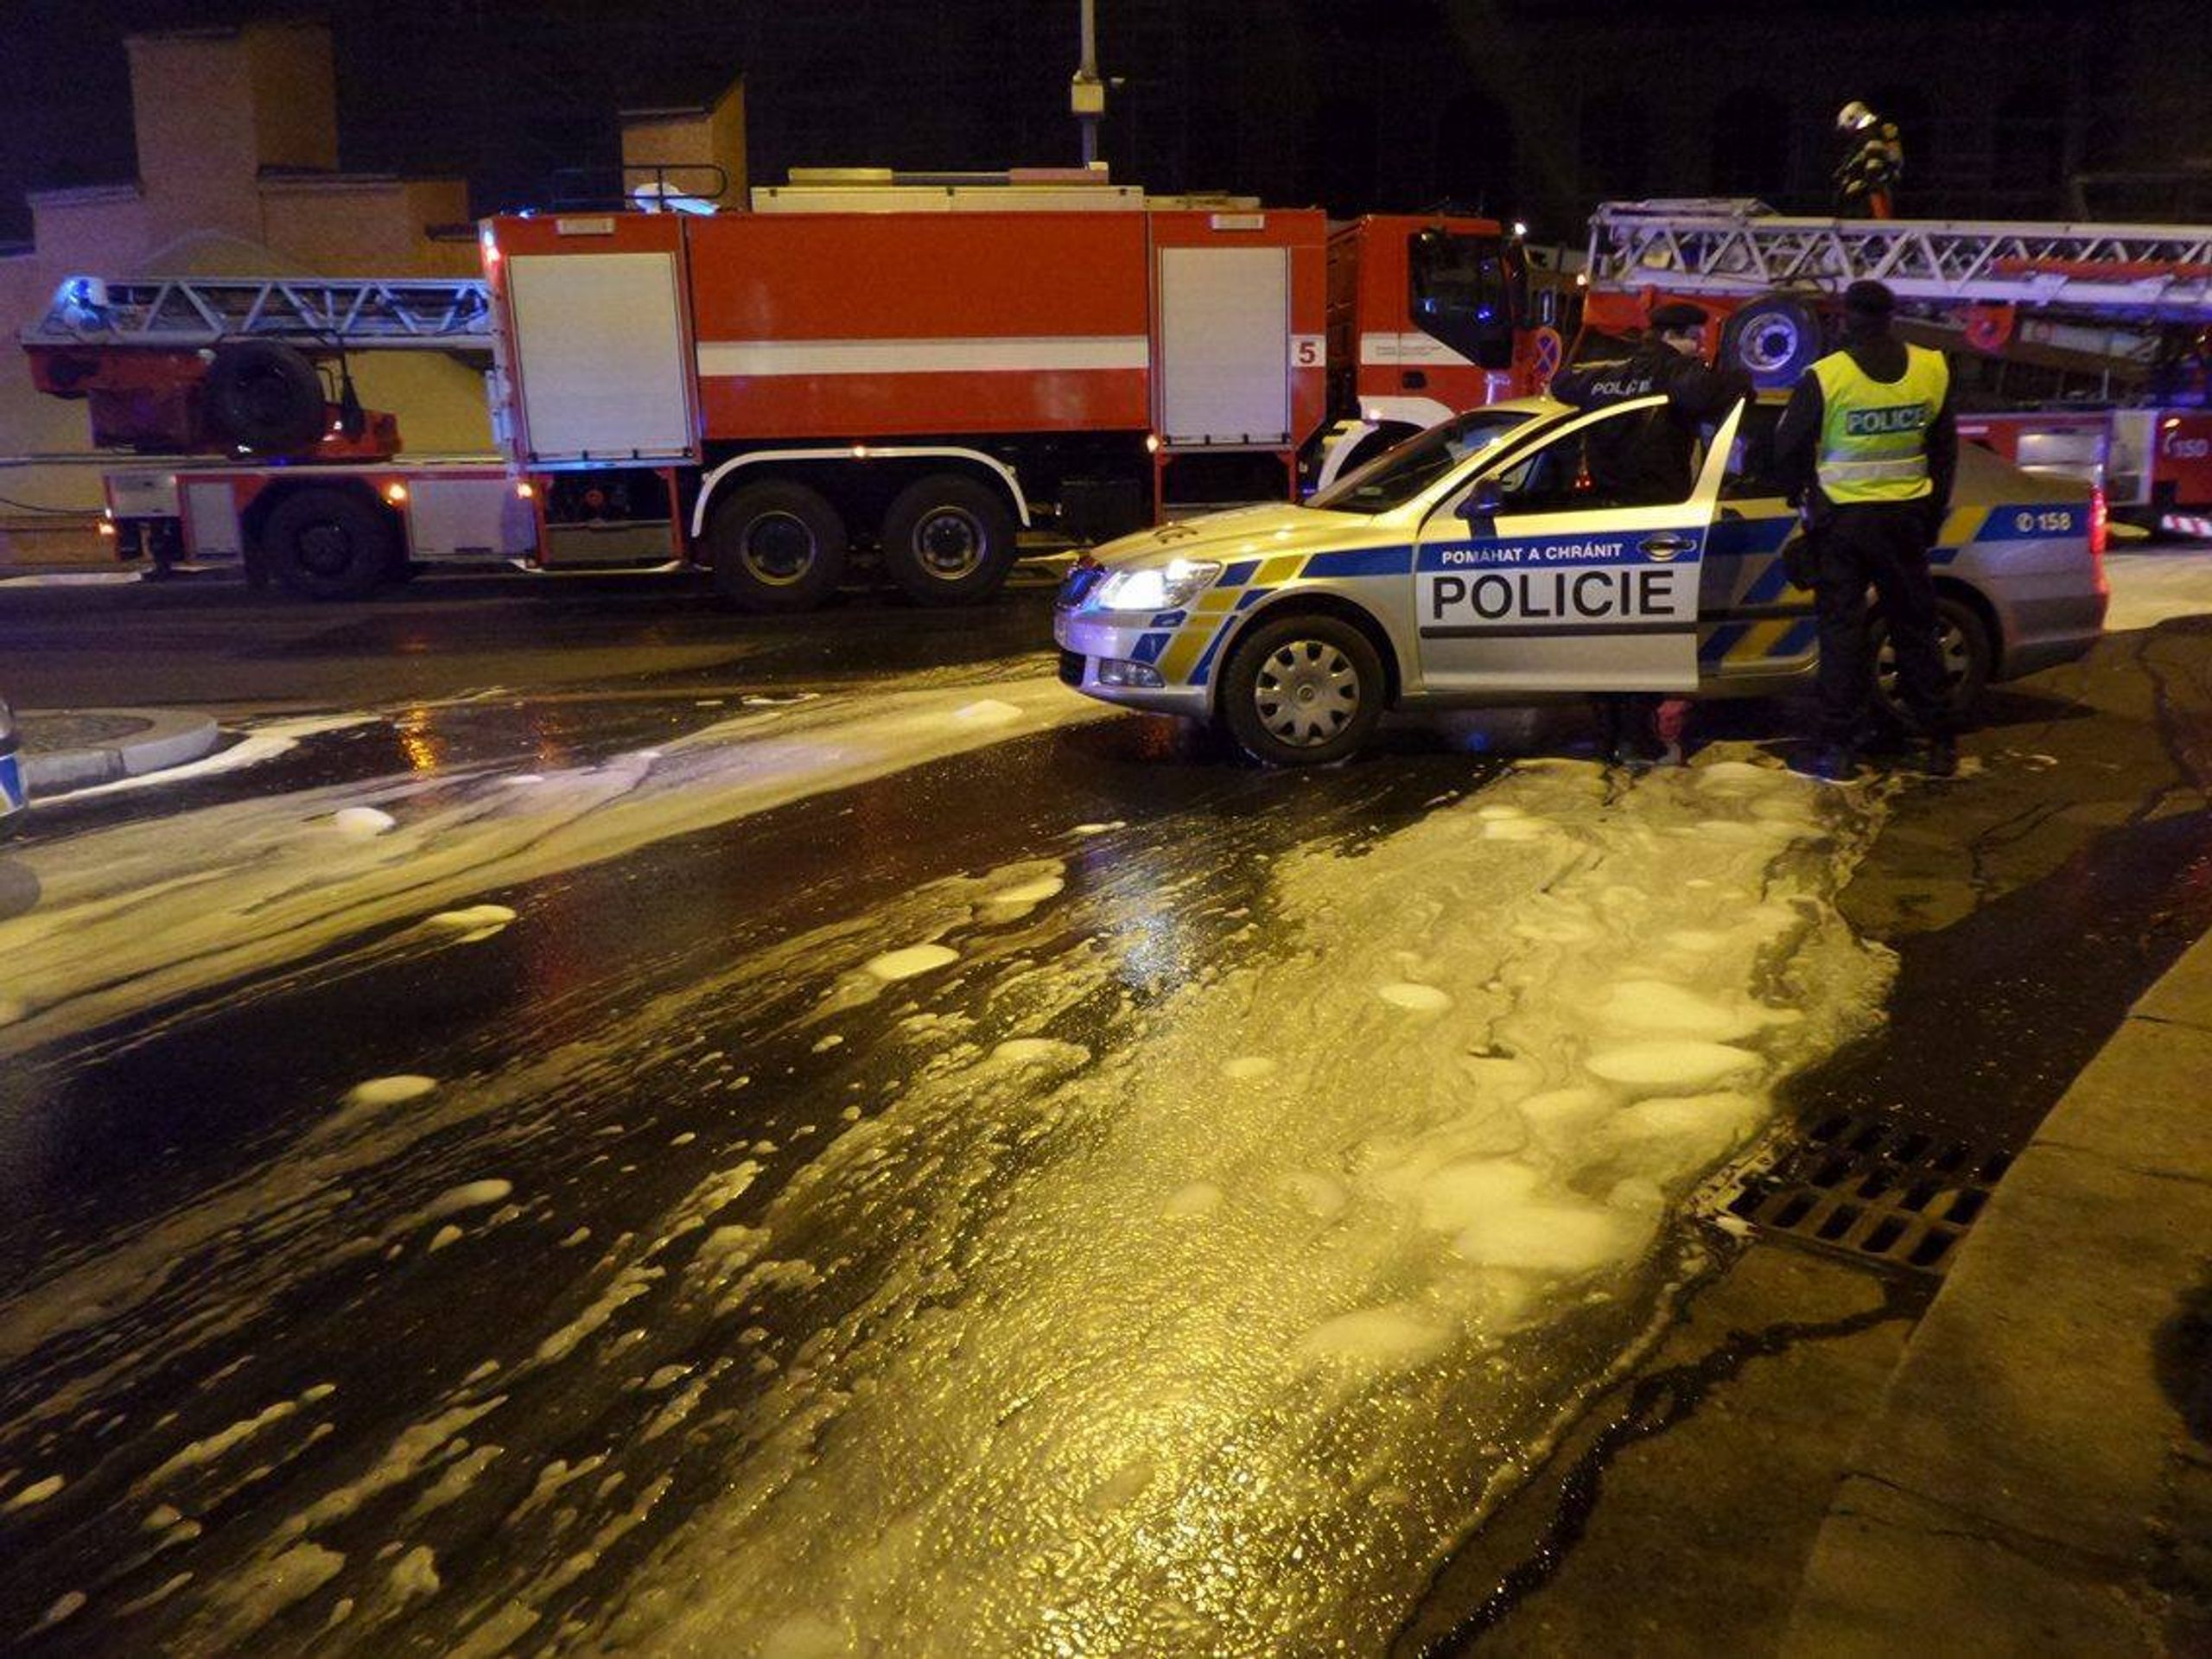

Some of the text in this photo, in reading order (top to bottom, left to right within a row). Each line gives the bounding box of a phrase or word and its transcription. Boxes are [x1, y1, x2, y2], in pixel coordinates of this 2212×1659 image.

[1299, 341, 1315, 364] 5
[2175, 438, 2209, 458] 150
[2038, 512, 2072, 531] 158
[1442, 541, 1624, 565] POMÁHAT A CHRÁNIT
[1432, 569, 1675, 620] POLICIE
